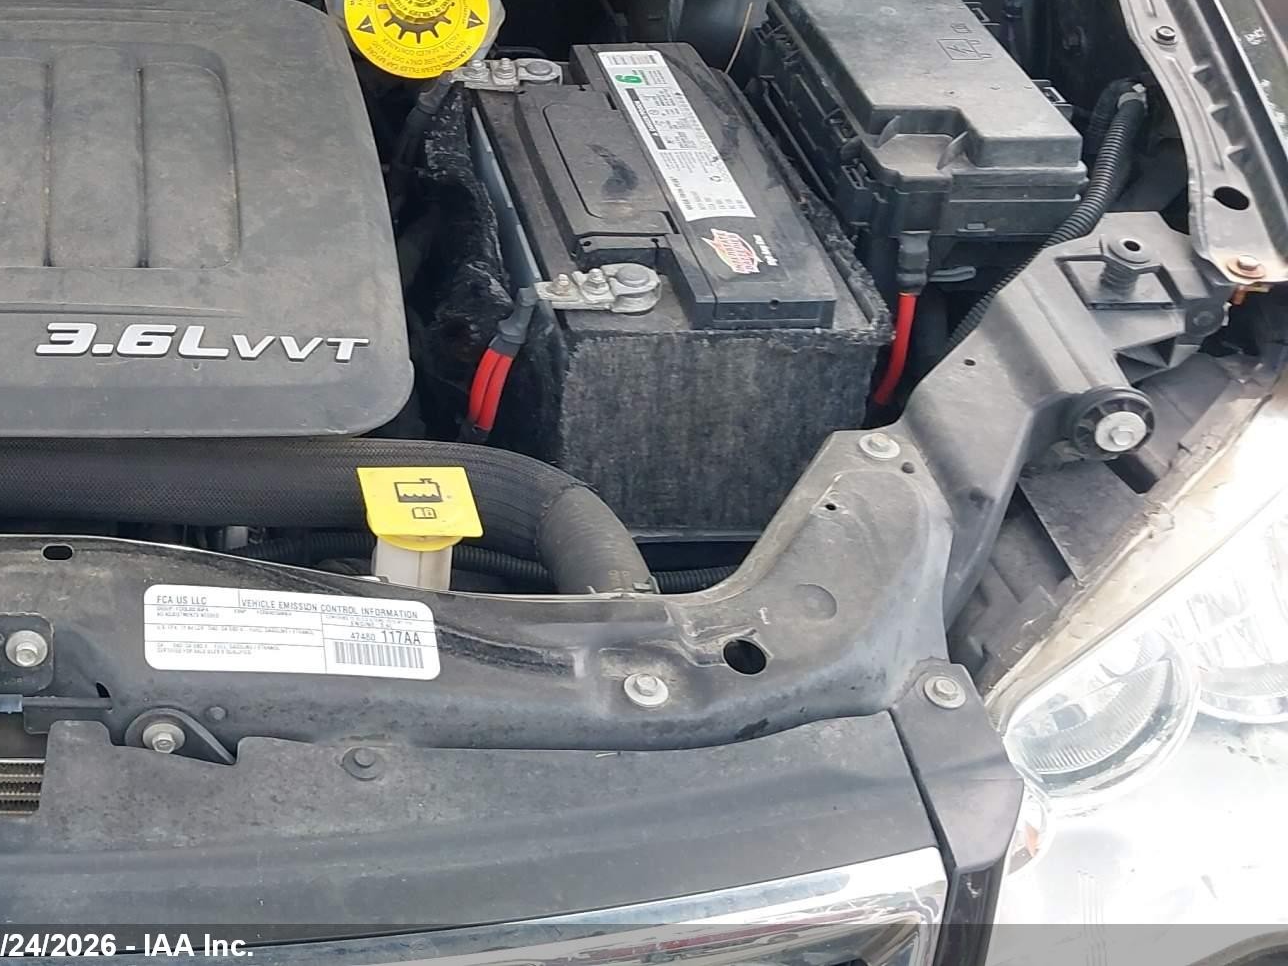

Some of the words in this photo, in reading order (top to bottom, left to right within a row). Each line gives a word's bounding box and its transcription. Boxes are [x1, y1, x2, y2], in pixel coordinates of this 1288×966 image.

[35, 322, 230, 359] 3.6L
[231, 333, 370, 363] VVT
[156, 595, 173, 605] FCA
[176, 596, 188, 605] US
[191, 596, 207, 606] LLC
[241, 598, 276, 610] VEHICLE
[278, 600, 318, 612] EMISSION
[320, 603, 358, 615] CONTROL
[361, 607, 418, 619] INFORMATION
[382, 630, 422, 645] 117AA
